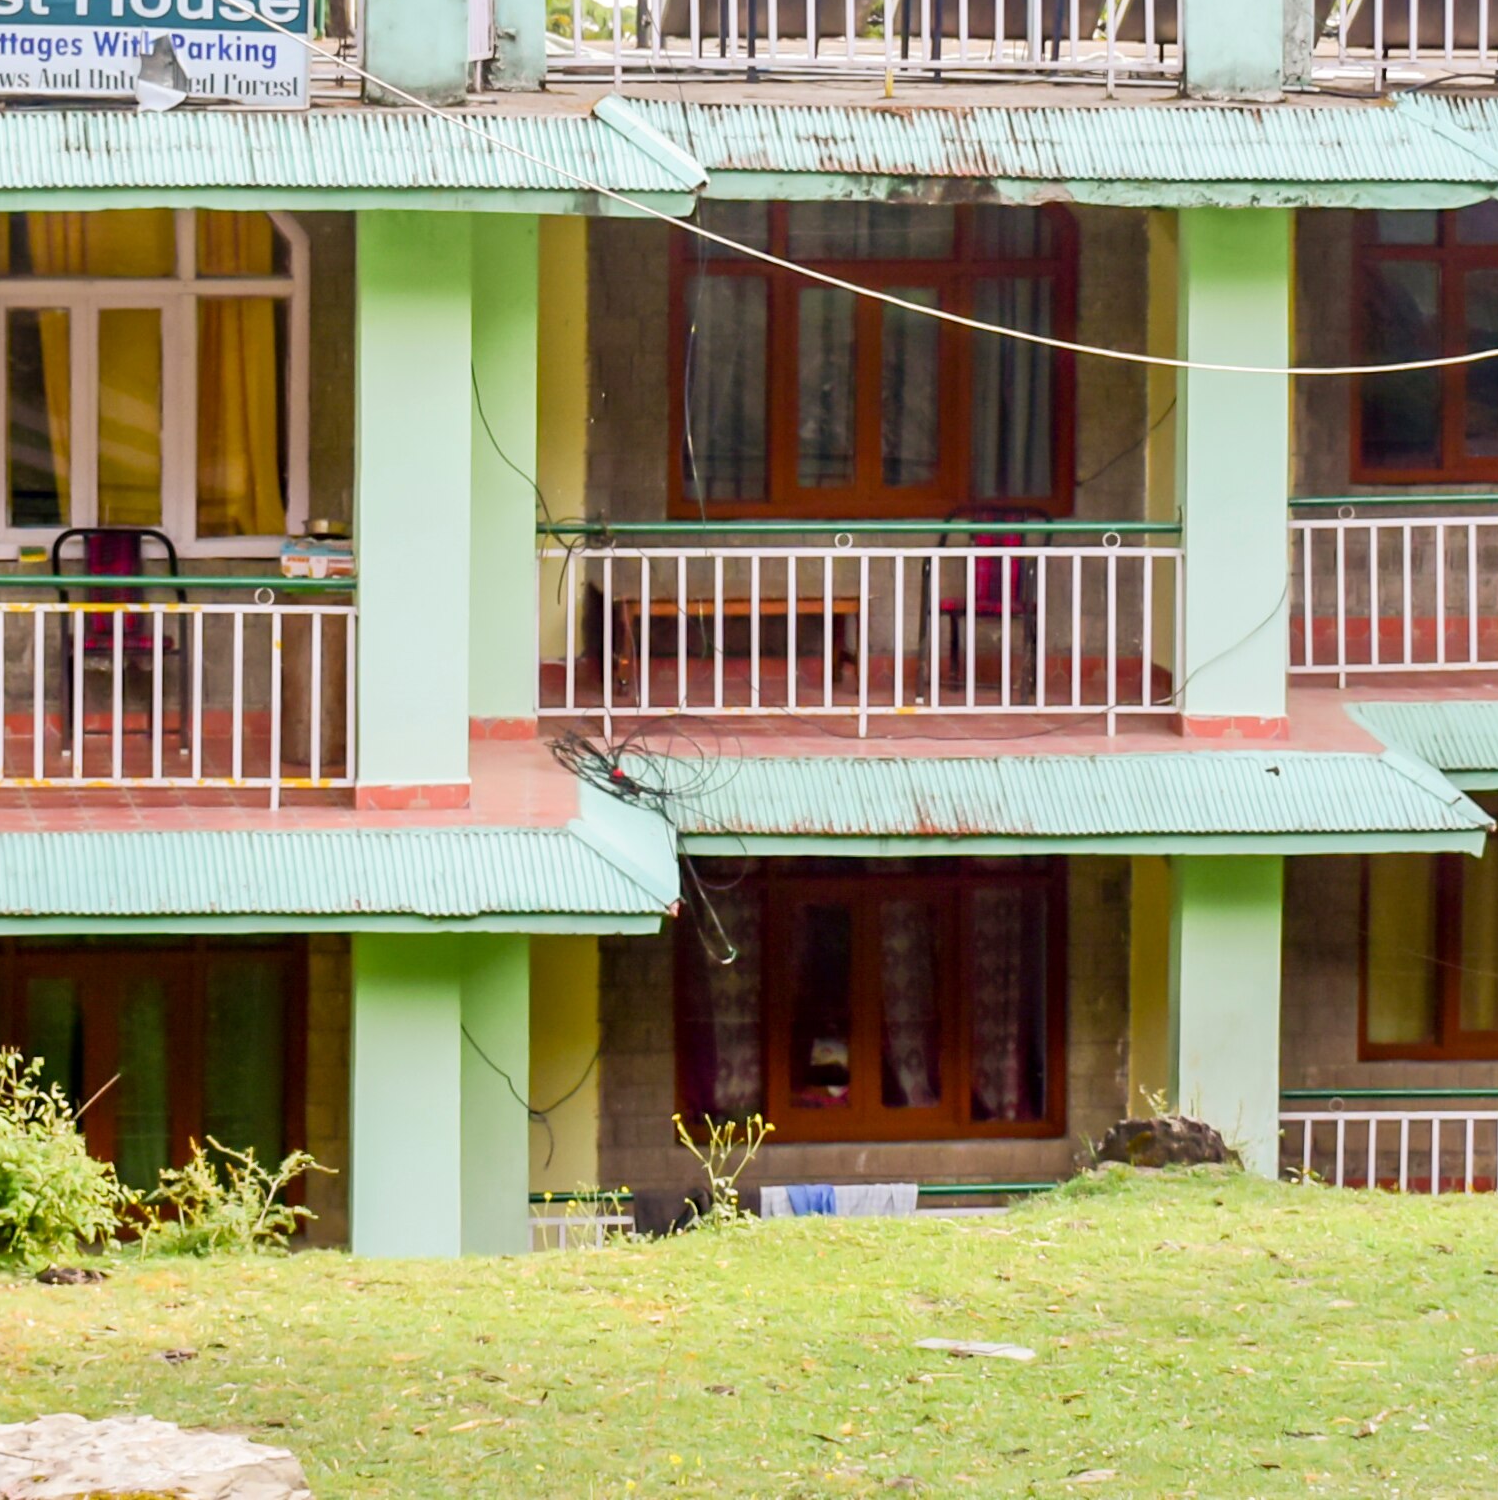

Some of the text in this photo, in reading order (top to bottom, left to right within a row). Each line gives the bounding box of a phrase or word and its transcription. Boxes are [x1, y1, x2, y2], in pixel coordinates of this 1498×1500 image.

[171, 32, 277, 70] Parking
[38, 67, 80, 90] And
[223, 73, 299, 97] Forest
